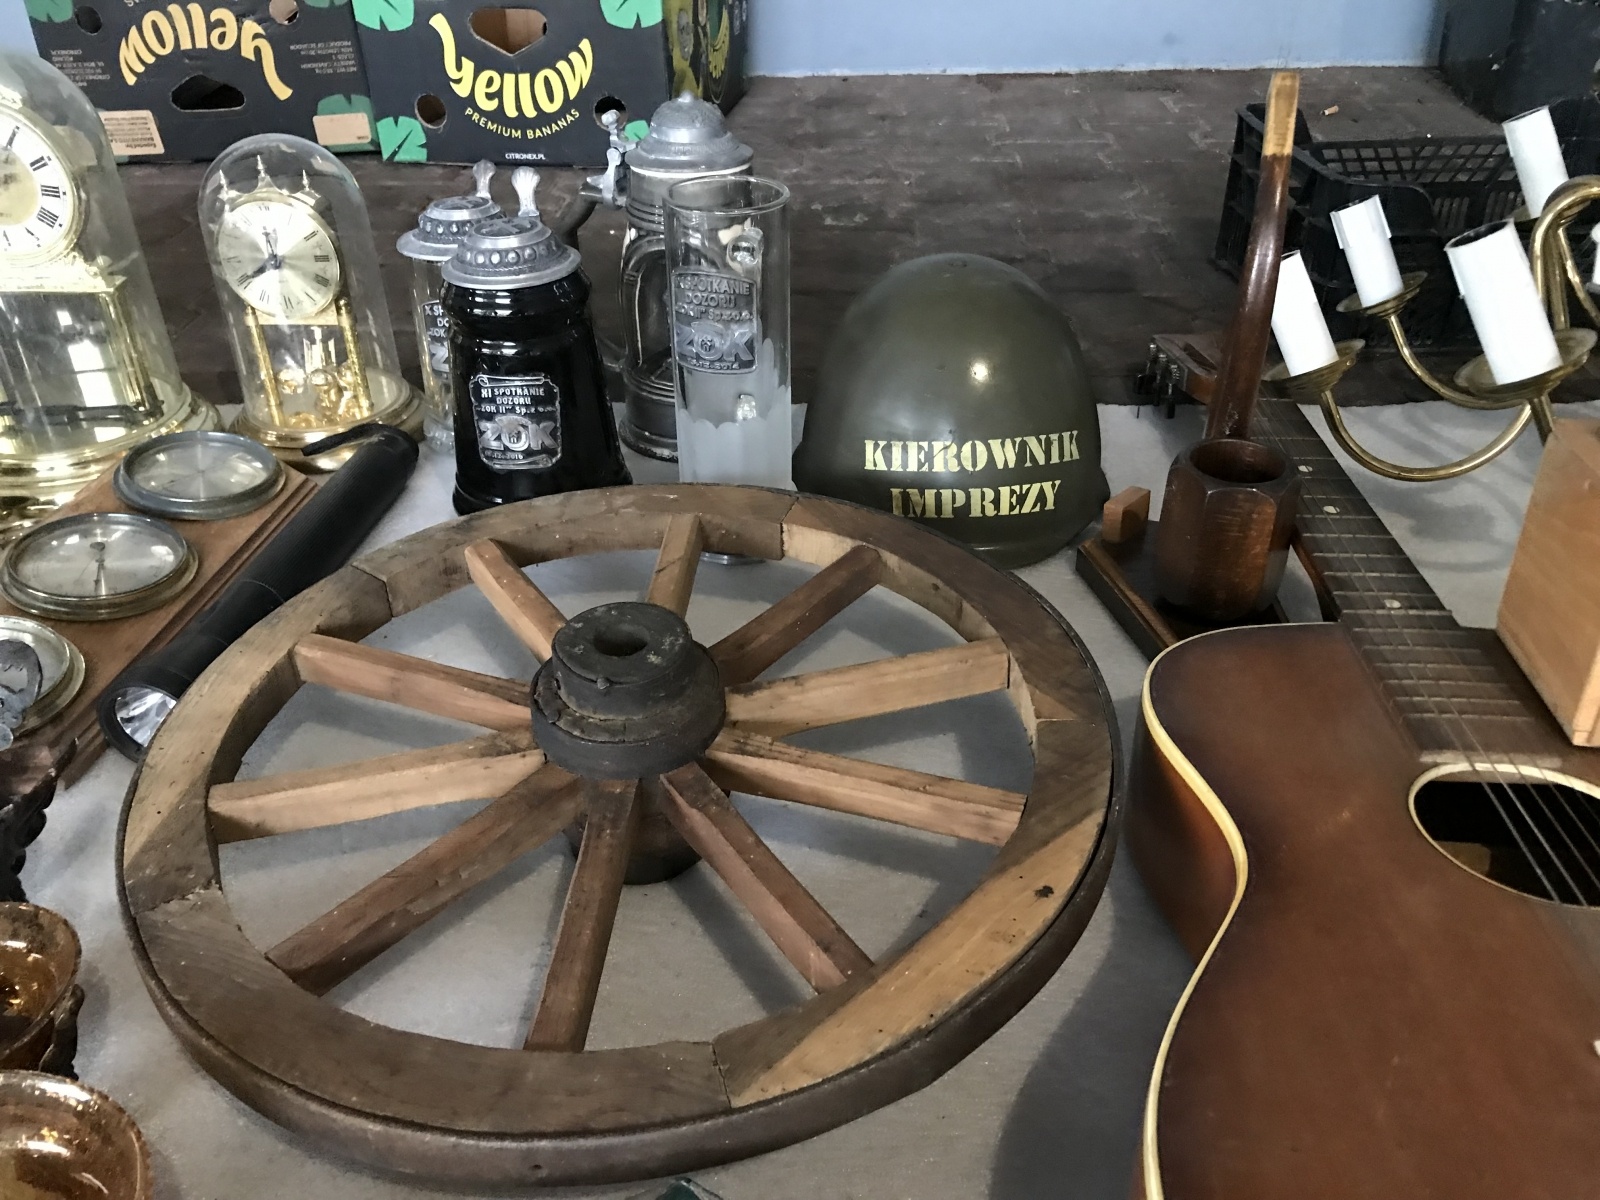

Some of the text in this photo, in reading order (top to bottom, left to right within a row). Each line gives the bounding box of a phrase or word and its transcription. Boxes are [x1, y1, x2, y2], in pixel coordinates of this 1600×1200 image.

[465, 107, 580, 140] PREMIUM BANANAS
[481, 387, 545, 398] XI SPOTKANIE
[496, 396, 531, 405] DOZORU
[864, 430, 1080, 473] KIEROWNIK
[890, 480, 1062, 519] IMPREZY
